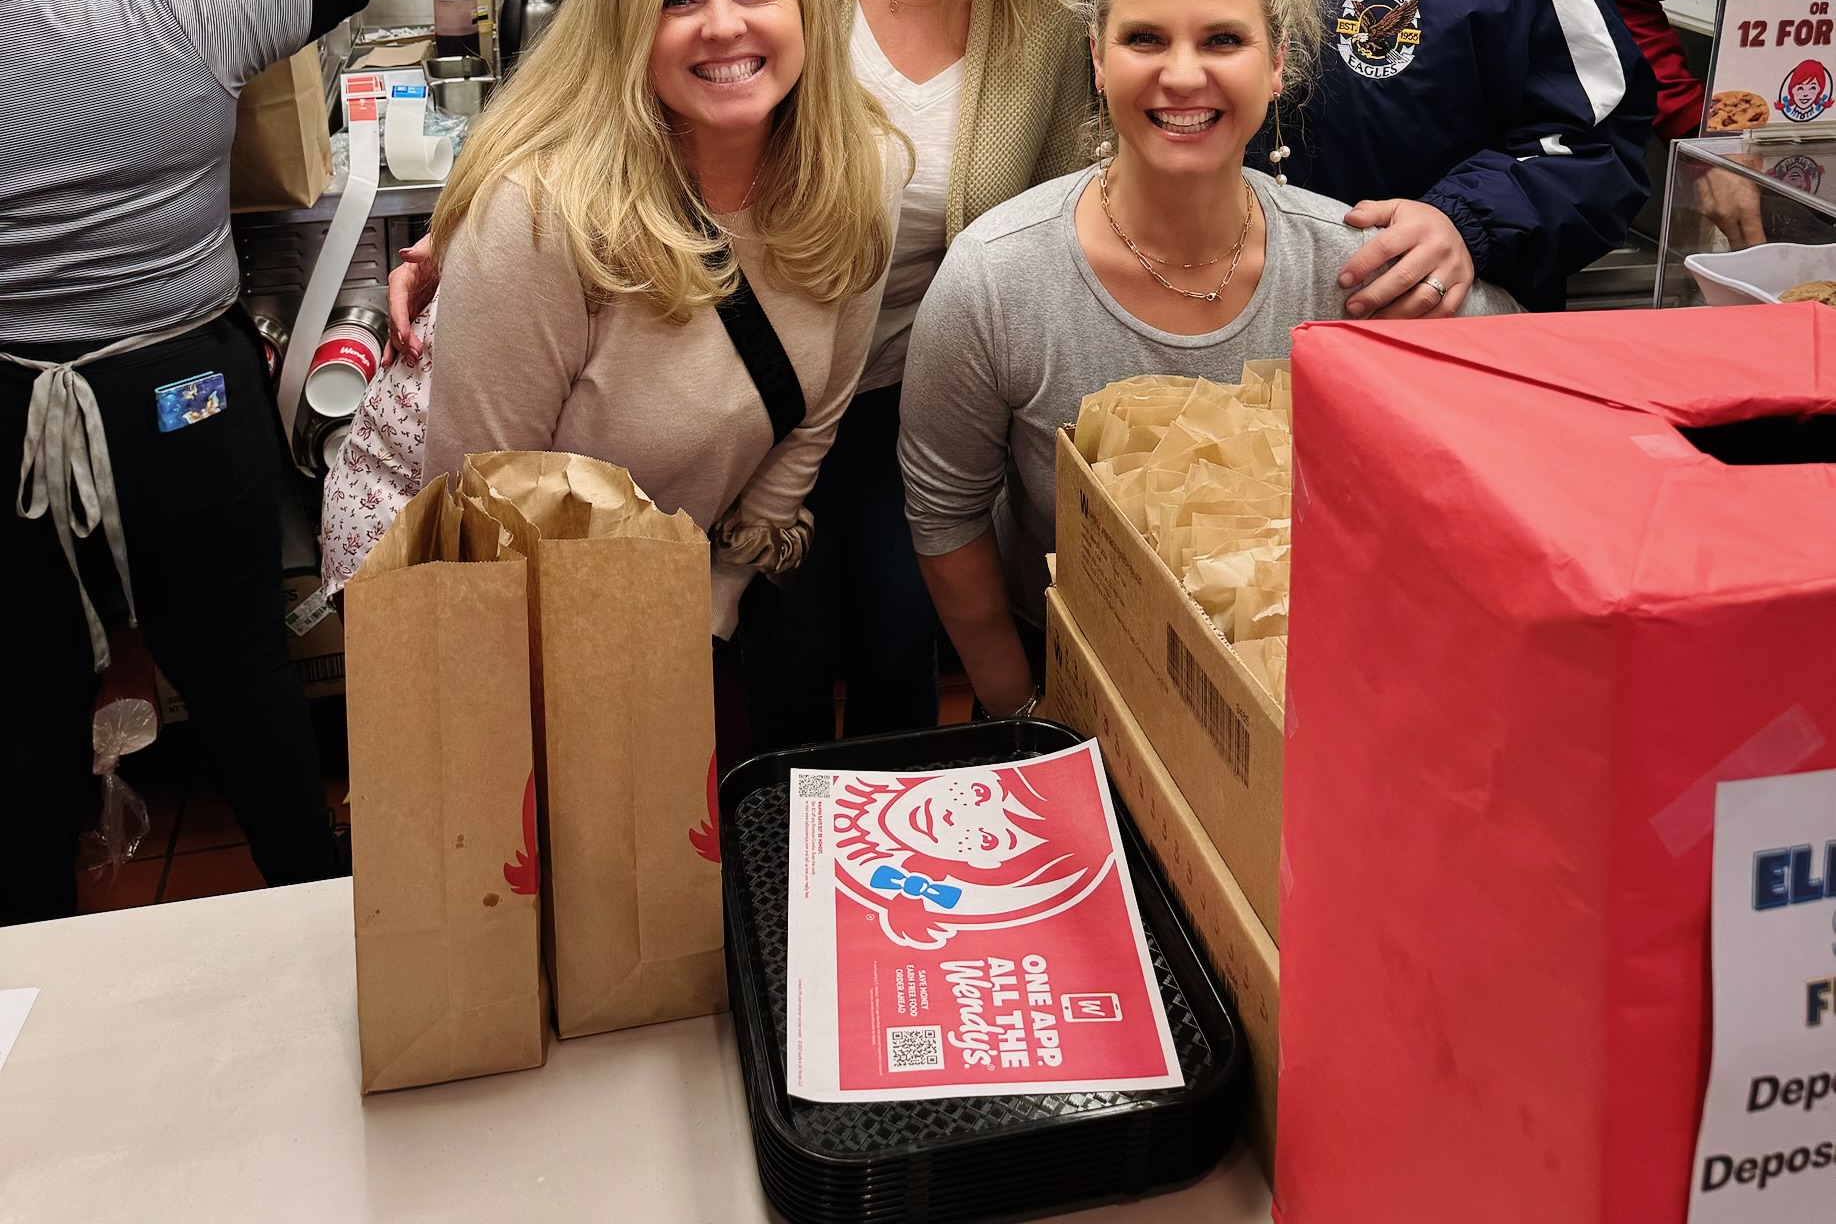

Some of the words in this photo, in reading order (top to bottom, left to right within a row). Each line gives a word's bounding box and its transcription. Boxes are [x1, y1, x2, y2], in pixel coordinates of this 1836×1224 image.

[1809, 1, 1829, 15] OR
[1339, 21, 1358, 32] EST.
[1400, 31, 1419, 42] 1955
[1737, 20, 1767, 48] 12
[1776, 19, 1834, 47] FOR
[1347, 54, 1398, 77] EAGLES
[895, 968, 904, 990] ORDER
[906, 964, 915, 980] EARN
[918, 969, 927, 989] SAVE
[987, 957, 1020, 1006] ALL
[1021, 954, 1053, 1006] ONE
[908, 980, 917, 998] FREE
[920, 989, 930, 1011] MONEY
[897, 991, 906, 1014] AHEAD
[909, 998, 918, 1017] FOOD
[1805, 978, 1836, 1029] F
[995, 1010, 1030, 1068] THE
[1030, 1010, 1063, 1067] APP.
[1746, 1071, 1836, 1114] Dep
[1701, 1140, 1836, 1193] Depos
